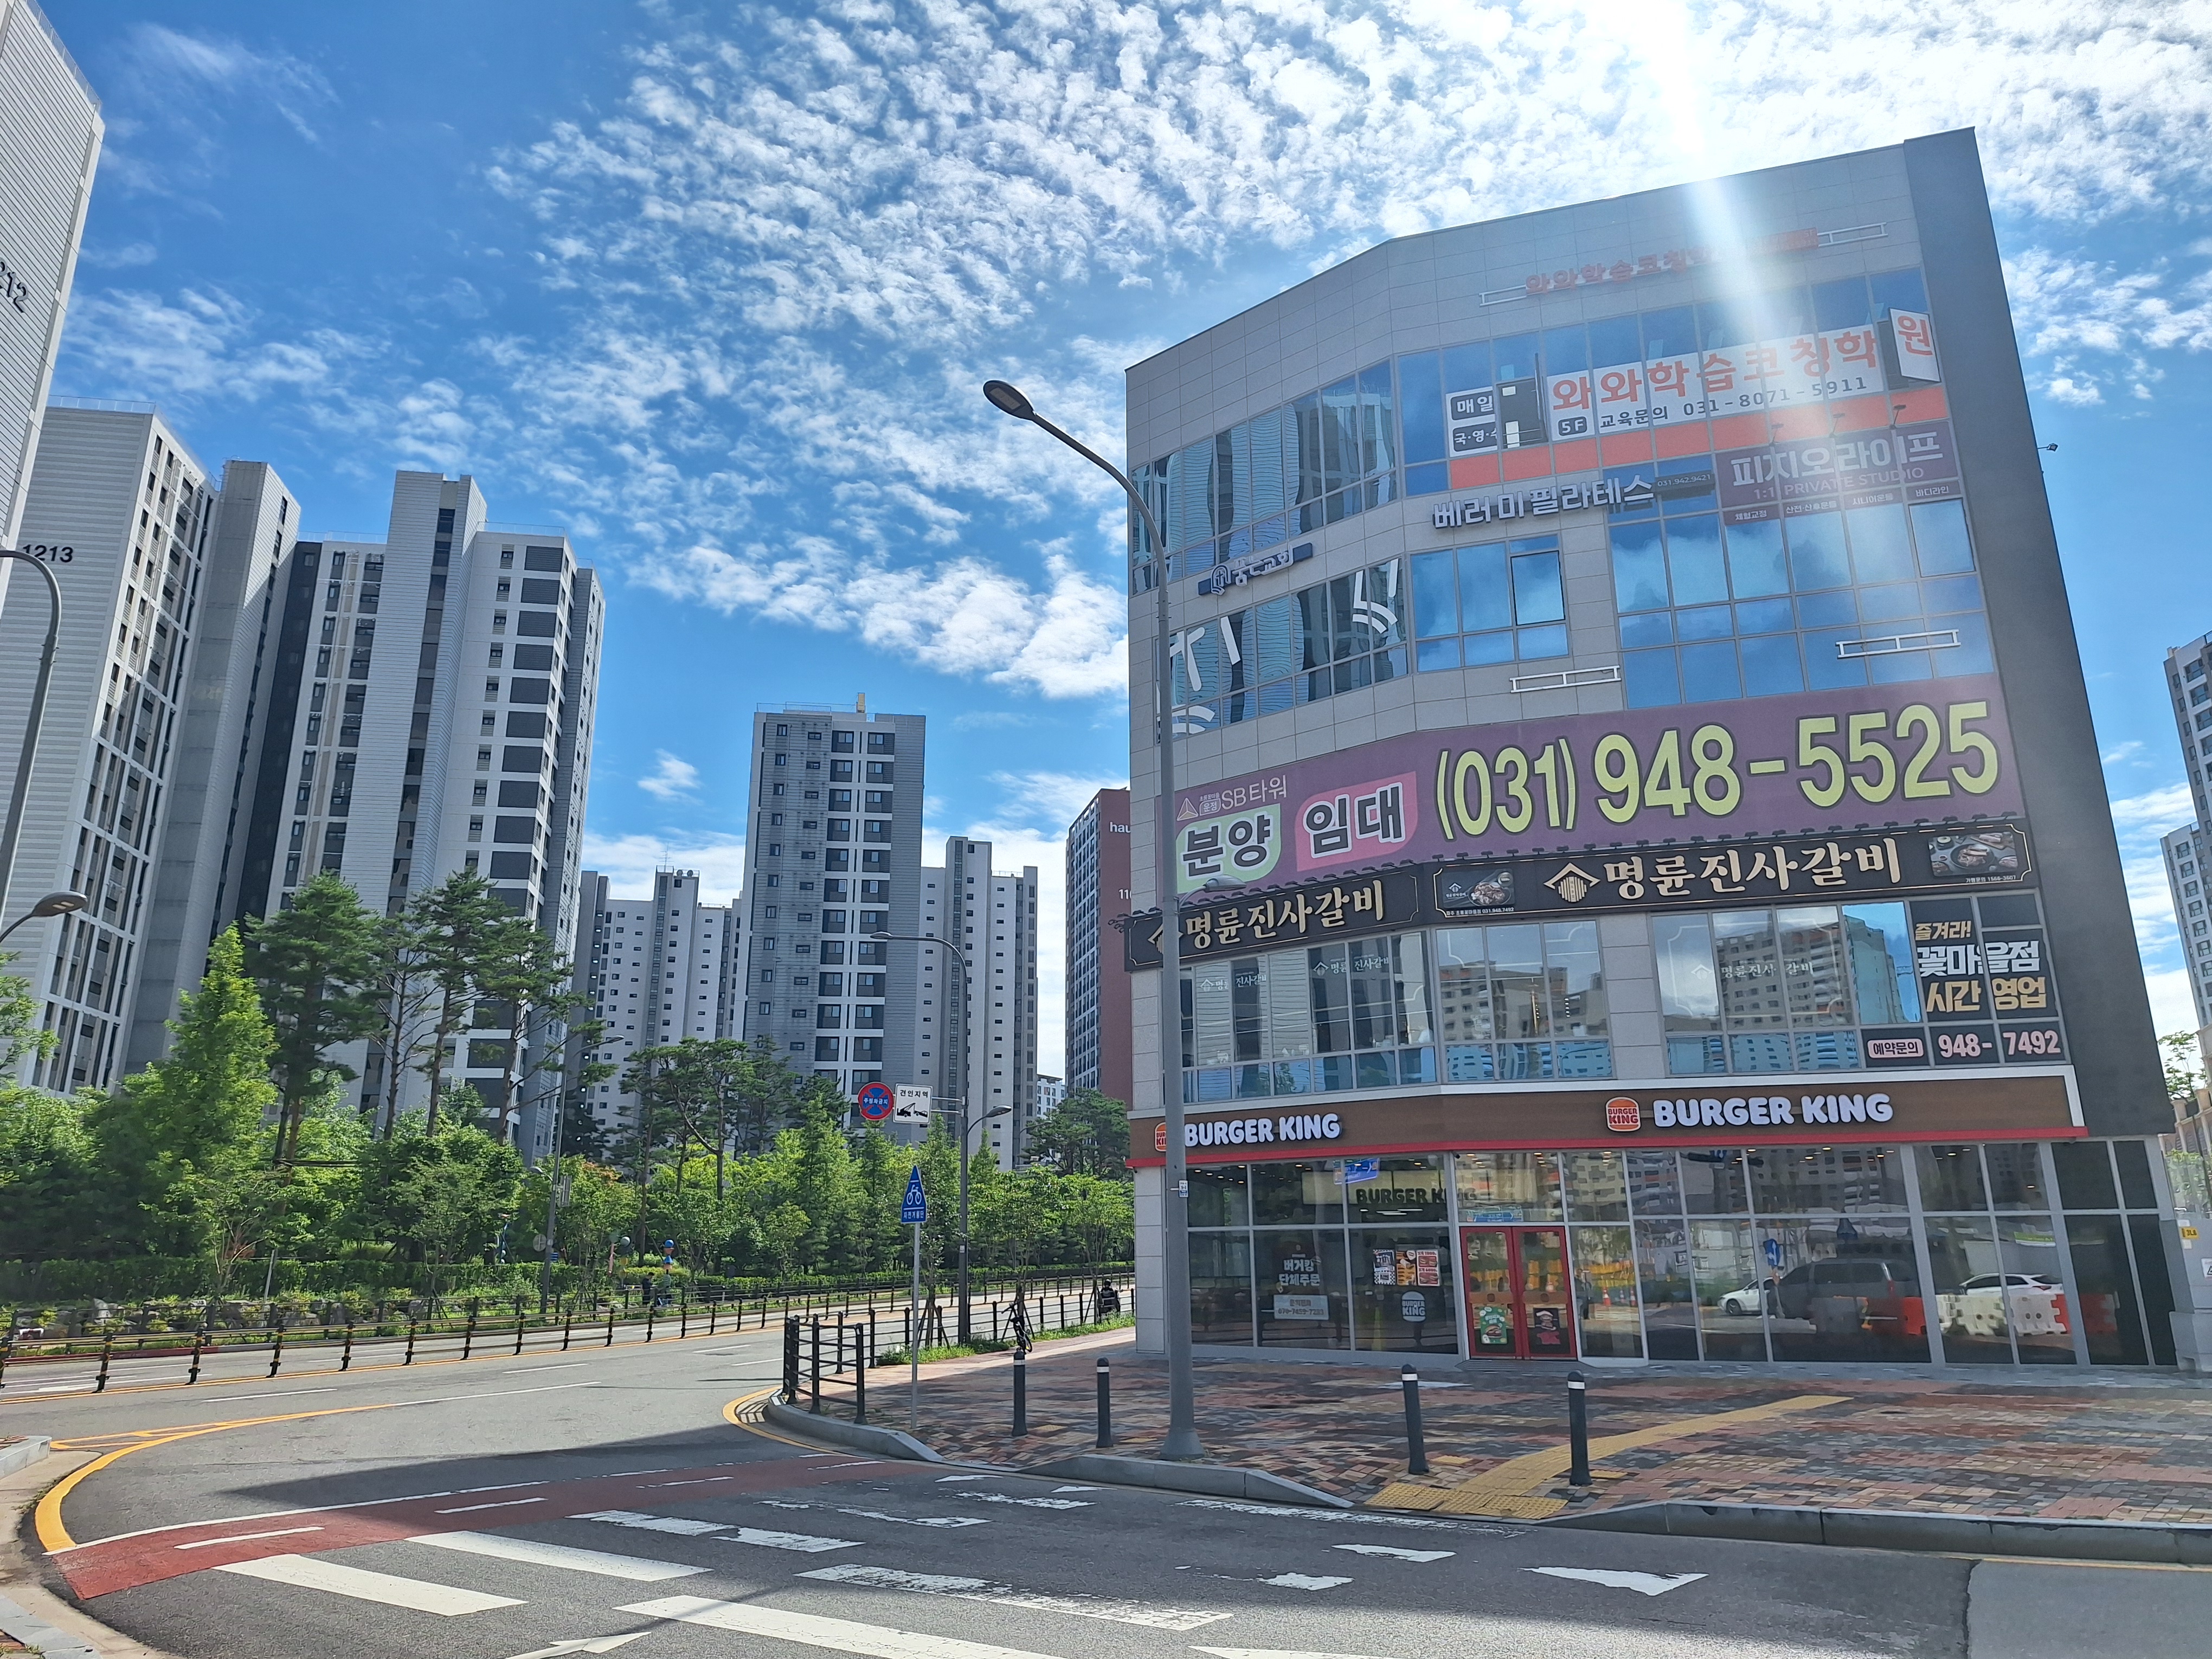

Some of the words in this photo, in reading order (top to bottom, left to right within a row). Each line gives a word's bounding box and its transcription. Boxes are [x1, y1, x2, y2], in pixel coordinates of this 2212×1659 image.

[1552, 315, 1934, 411] 와와학습코칭학원
[1457, 395, 1493, 413] 매일
[1561, 417, 1584, 434] 5F
[1599, 405, 1669, 429] 교육문의
[1731, 432, 1944, 486] 피지오라이프
[1657, 474, 1711, 488] 031.942.9421
[1753, 487, 1774, 499] 1:1
[1784, 477, 1855, 496] PRIVATE
[1858, 467, 1924, 486] STUDIO
[1436, 738, 1576, 839] (031)
[1594, 700, 1999, 824] 948-5525
[1221, 775, 1287, 810] SB타워
[1204, 801, 1217, 812] 운정
[1182, 814, 1271, 877] 분양
[1306, 786, 1403, 855] 임대
[1604, 838, 1901, 899] 명륜진사갈비
[1118, 889, 1131, 899] 11
[1187, 879, 1384, 949] 명륜진사갈비
[1915, 921, 1971, 941] 즐겨라!
[1917, 941, 2040, 977] 꽃마을점
[1926, 980, 1982, 1013] 시간
[1991, 976, 2047, 1010] 영업
[1873, 1041, 1918, 1055] 예약문의
[2003, 1030, 2061, 1056] 7492
[899, 1089, 928, 1098] 견인지역
[1608, 1107, 1638, 1116] BURGER
[1609, 1114, 1638, 1124] KING
[1653, 1097, 1795, 1127] BURGER
[1801, 1093, 1894, 1123] KING
[1185, 1118, 1274, 1147] BURGER
[1278, 1113, 1341, 1142] KING
[1356, 1188, 1427, 1204] BURGER
[1283, 1259, 1314, 1271] 버거킹
[1278, 1274, 1320, 1287] 단체주문
[1403, 1307, 1426, 1316] KING
